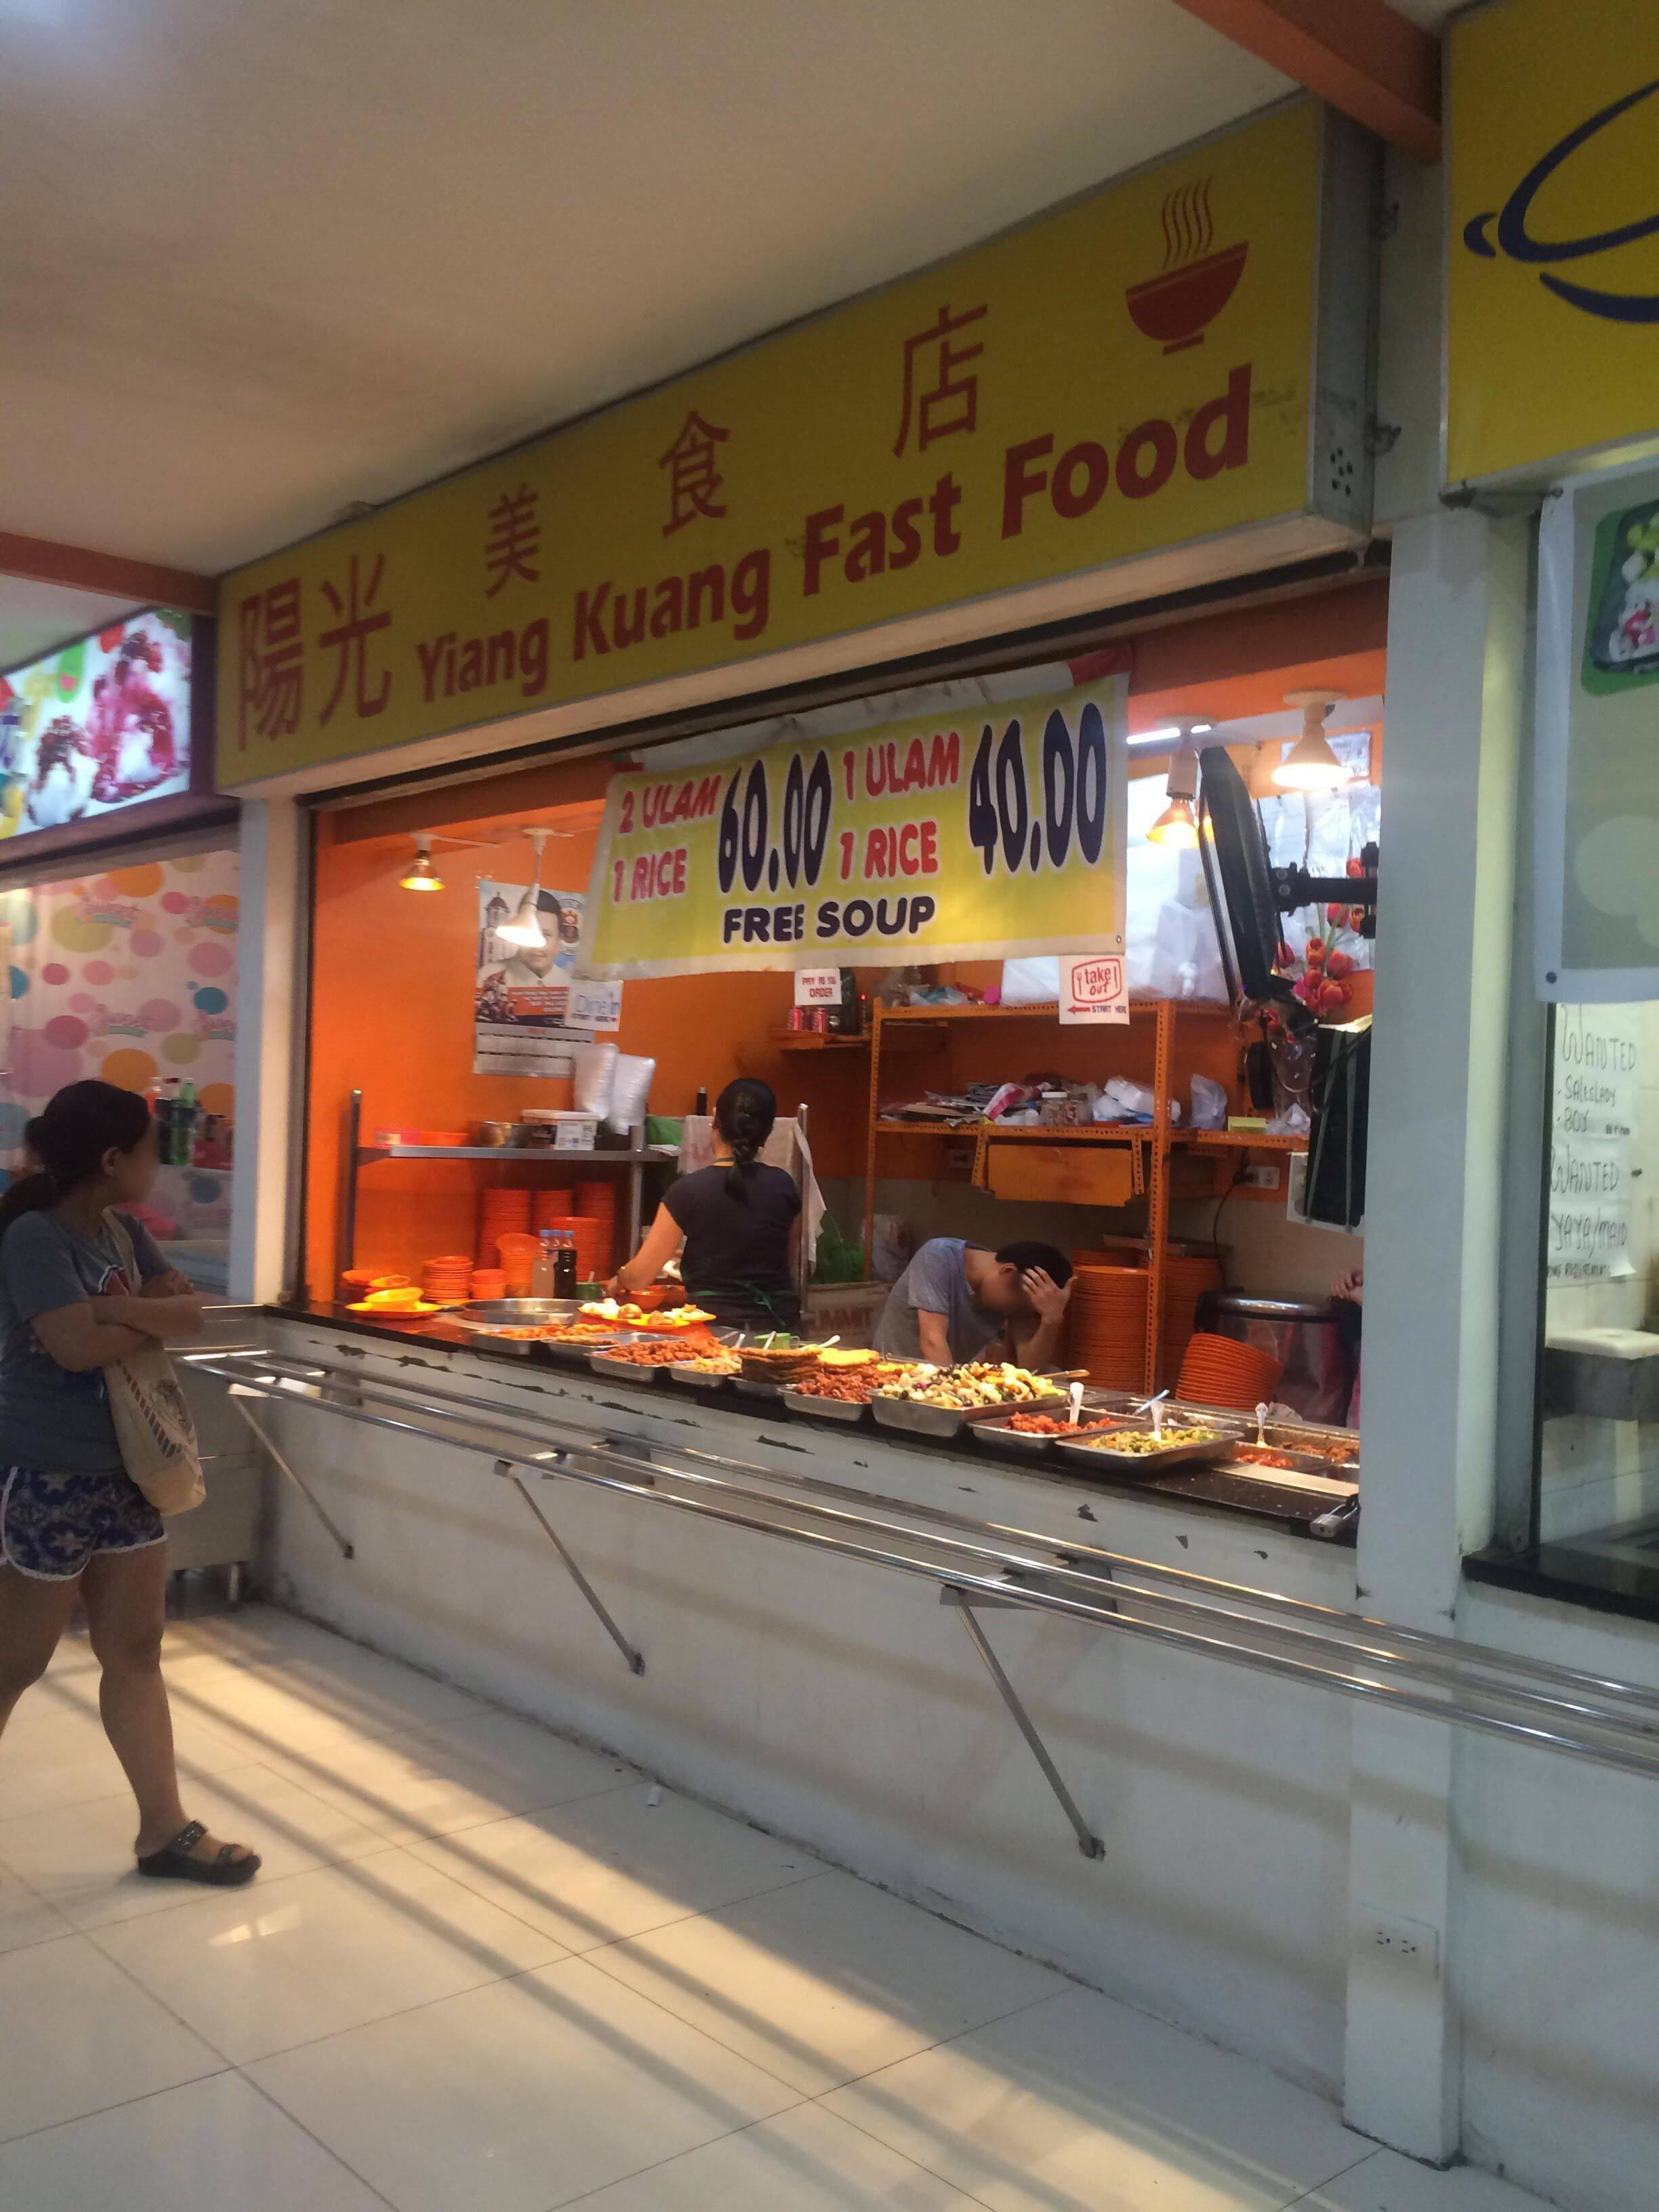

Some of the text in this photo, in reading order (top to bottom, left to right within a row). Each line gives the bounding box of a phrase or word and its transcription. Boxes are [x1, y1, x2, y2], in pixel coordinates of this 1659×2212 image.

[415, 362, 1253, 705] Yiang Kuang Fast Food
[842, 731, 960, 801] 1 ULAM
[969, 702, 1107, 876] 40.00
[618, 775, 722, 834] 2 ULAM
[718, 749, 832, 894] 60.00
[613, 848, 687, 903] 1 RICE
[840, 821, 939, 880] 1 RICE
[723, 895, 936, 944] FREE SOUP
[1084, 966, 1111, 985] take
[1561, 1003, 1637, 1072] WANTED
[1551, 1143, 1620, 1194] WANTED
